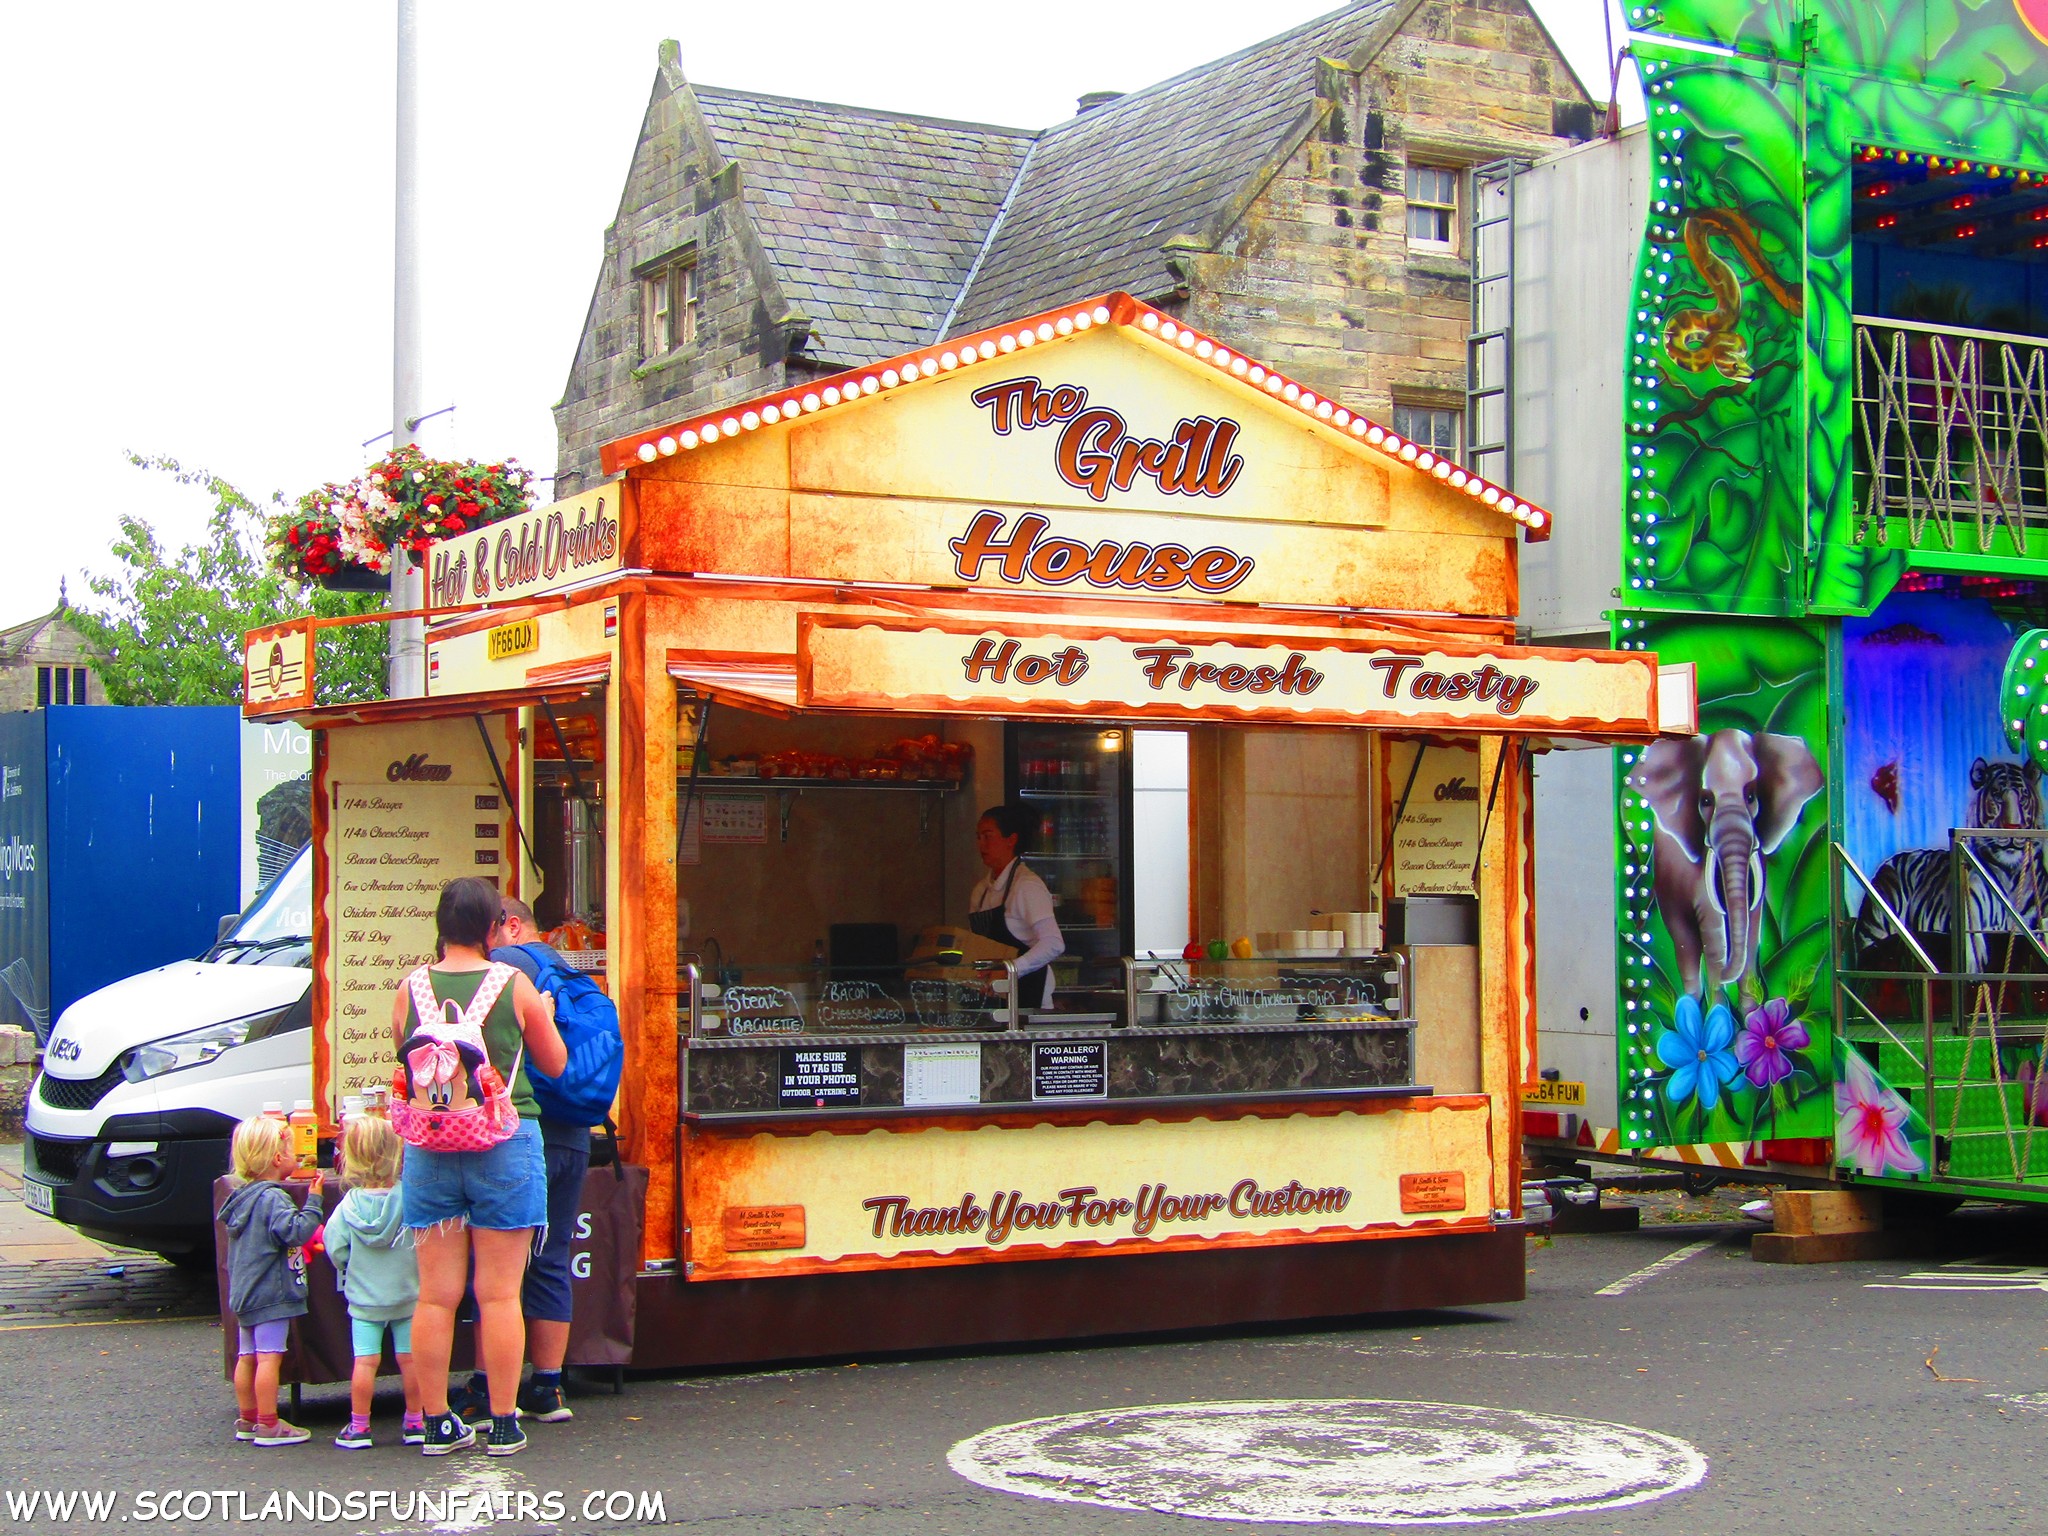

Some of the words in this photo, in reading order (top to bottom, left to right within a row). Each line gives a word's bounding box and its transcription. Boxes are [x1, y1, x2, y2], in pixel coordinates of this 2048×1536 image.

[971, 377, 1088, 435] The
[1055, 406, 1244, 502] Grill
[432, 549, 467, 607] Hot
[473, 536, 490, 599] &
[494, 518, 543, 591] Cold
[542, 496, 618, 580] Drinks
[948, 510, 1255, 594] House
[491, 627, 513, 656] YF66
[514, 623, 533, 650] OJX
[963, 637, 1089, 687] Hot
[1134, 646, 1325, 696] Fresh
[1369, 656, 1540, 715] Tasty
[264, 728, 312, 754] Ma
[264, 769, 286, 781] The
[368, 797, 403, 814] Burger
[1416, 813, 1442, 826] Burger
[369, 825, 429, 842] CheeseBurger
[344, 852, 378, 865] Bacon
[379, 852, 440, 869] CheeseBurger
[1400, 860, 1424, 871] Bacon
[361, 879, 404, 892] Aberdeen
[1413, 882, 1444, 892] Aberdeen
[343, 905, 377, 919] Chicken
[343, 930, 364, 943] Hot
[367, 930, 392, 946] Dog
[343, 954, 366, 967] Foot
[369, 954, 394, 969] Long
[397, 954, 420, 970] Grill
[343, 978, 376, 991] Bacon
[830, 983, 870, 1002] BACON
[729, 989, 783, 1013] Steak
[1176, 984, 1211, 1011] Salt
[1220, 986, 1249, 1008] Chilli
[1253, 990, 1293, 1009] Chicken
[343, 1003, 367, 1019] Chips
[343, 1027, 367, 1044] Chips
[369, 1027, 379, 1039] &
[795, 1052, 821, 1062] MAKE
[823, 1052, 846, 1061] SURE
[1063, 1046, 1099, 1054] ALLERGY
[343, 1051, 367, 1069] Chips
[369, 1051, 379, 1064] &
[799, 1064, 810, 1073] TO
[812, 1063, 829, 1073] TAG
[832, 1063, 844, 1072] US
[1051, 1056, 1088, 1064] WARNING
[343, 1076, 364, 1090] Hot
[785, 1076, 794, 1085] IN
[797, 1075, 820, 1085] YOUR
[823, 1074, 856, 1084] PHOTOS
[1557, 1084, 1579, 1101] FUW
[862, 1194, 987, 1238] Thank
[985, 1191, 1064, 1245] You
[1059, 1186, 1133, 1229] For
[1133, 1183, 1226, 1235] Your
[1227, 1178, 1352, 1219] Custom
